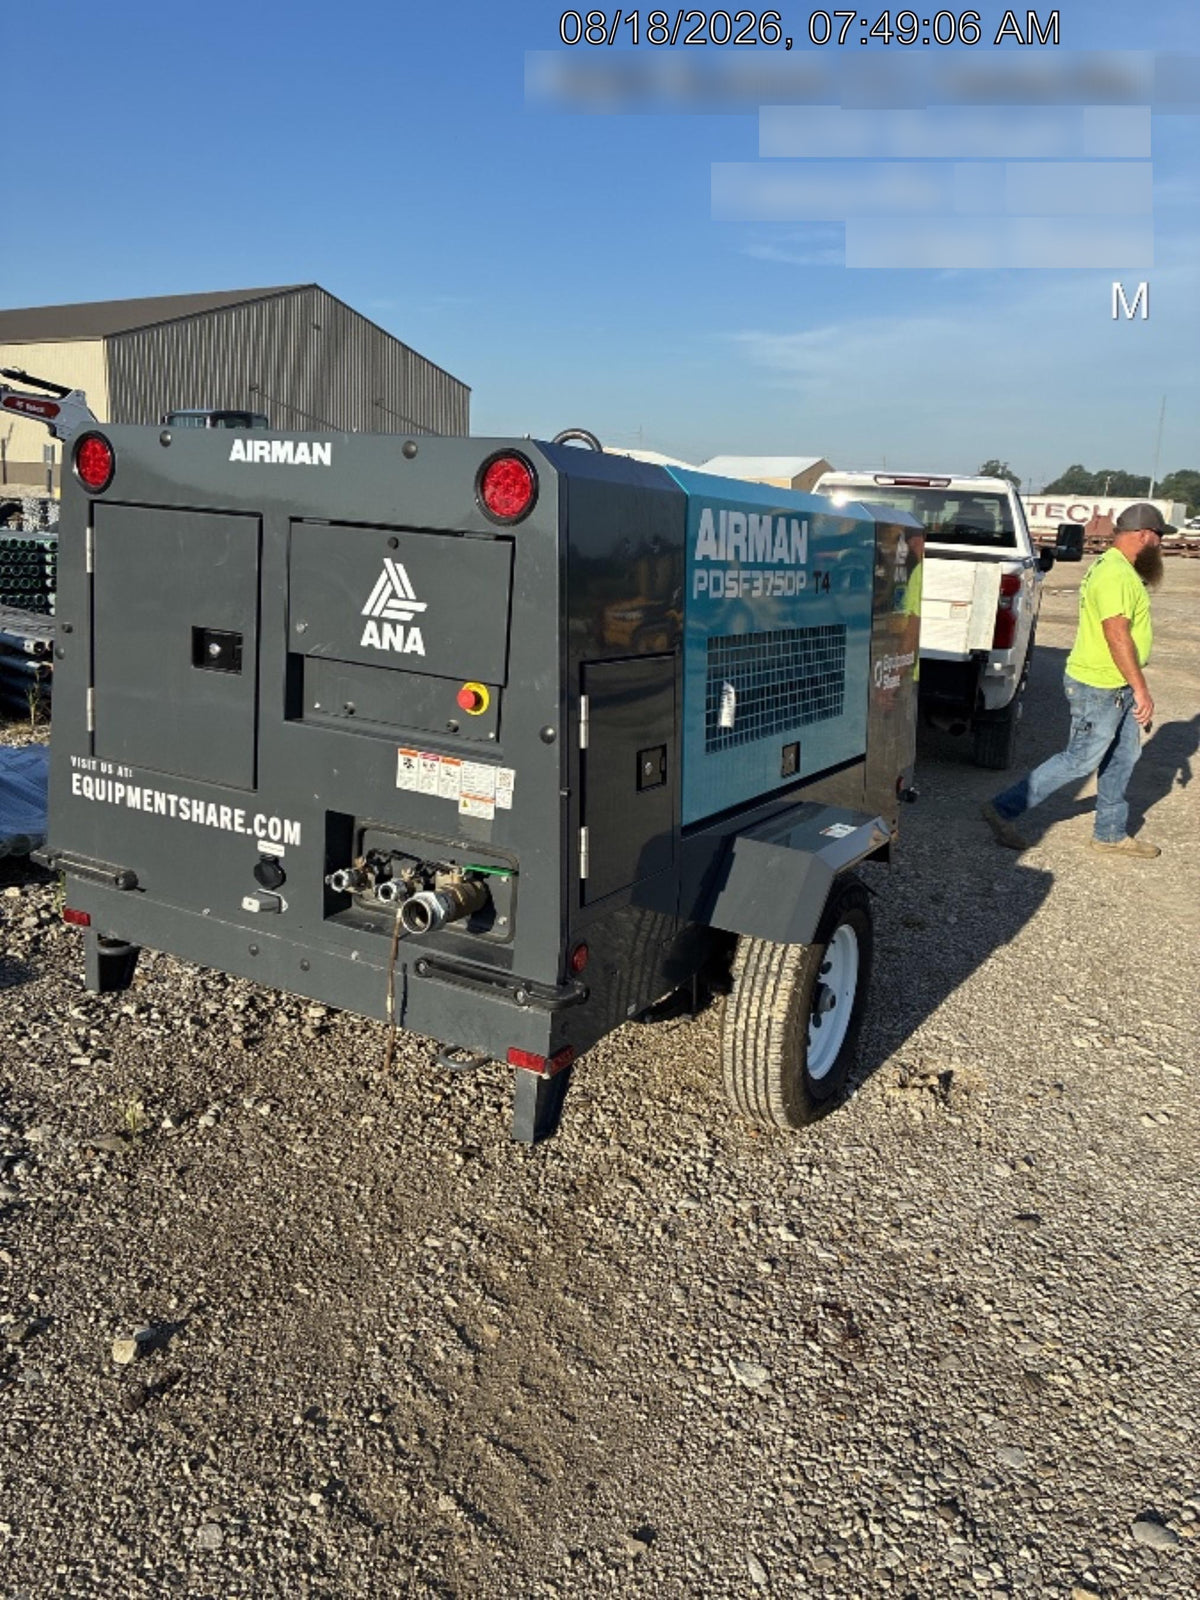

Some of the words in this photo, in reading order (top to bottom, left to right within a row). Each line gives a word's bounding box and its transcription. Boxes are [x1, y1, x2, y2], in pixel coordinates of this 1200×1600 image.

[229, 439, 332, 466] AIRMAN
[1026, 502, 1117, 529] TECH
[694, 507, 808, 565] AIRMAN
[813, 570, 830, 594] T4
[360, 620, 425, 656] ANA
[70, 755, 97, 770] VISIT
[100, 761, 113, 774] US
[71, 772, 301, 846] EQUIPMENTSHARE.COM
